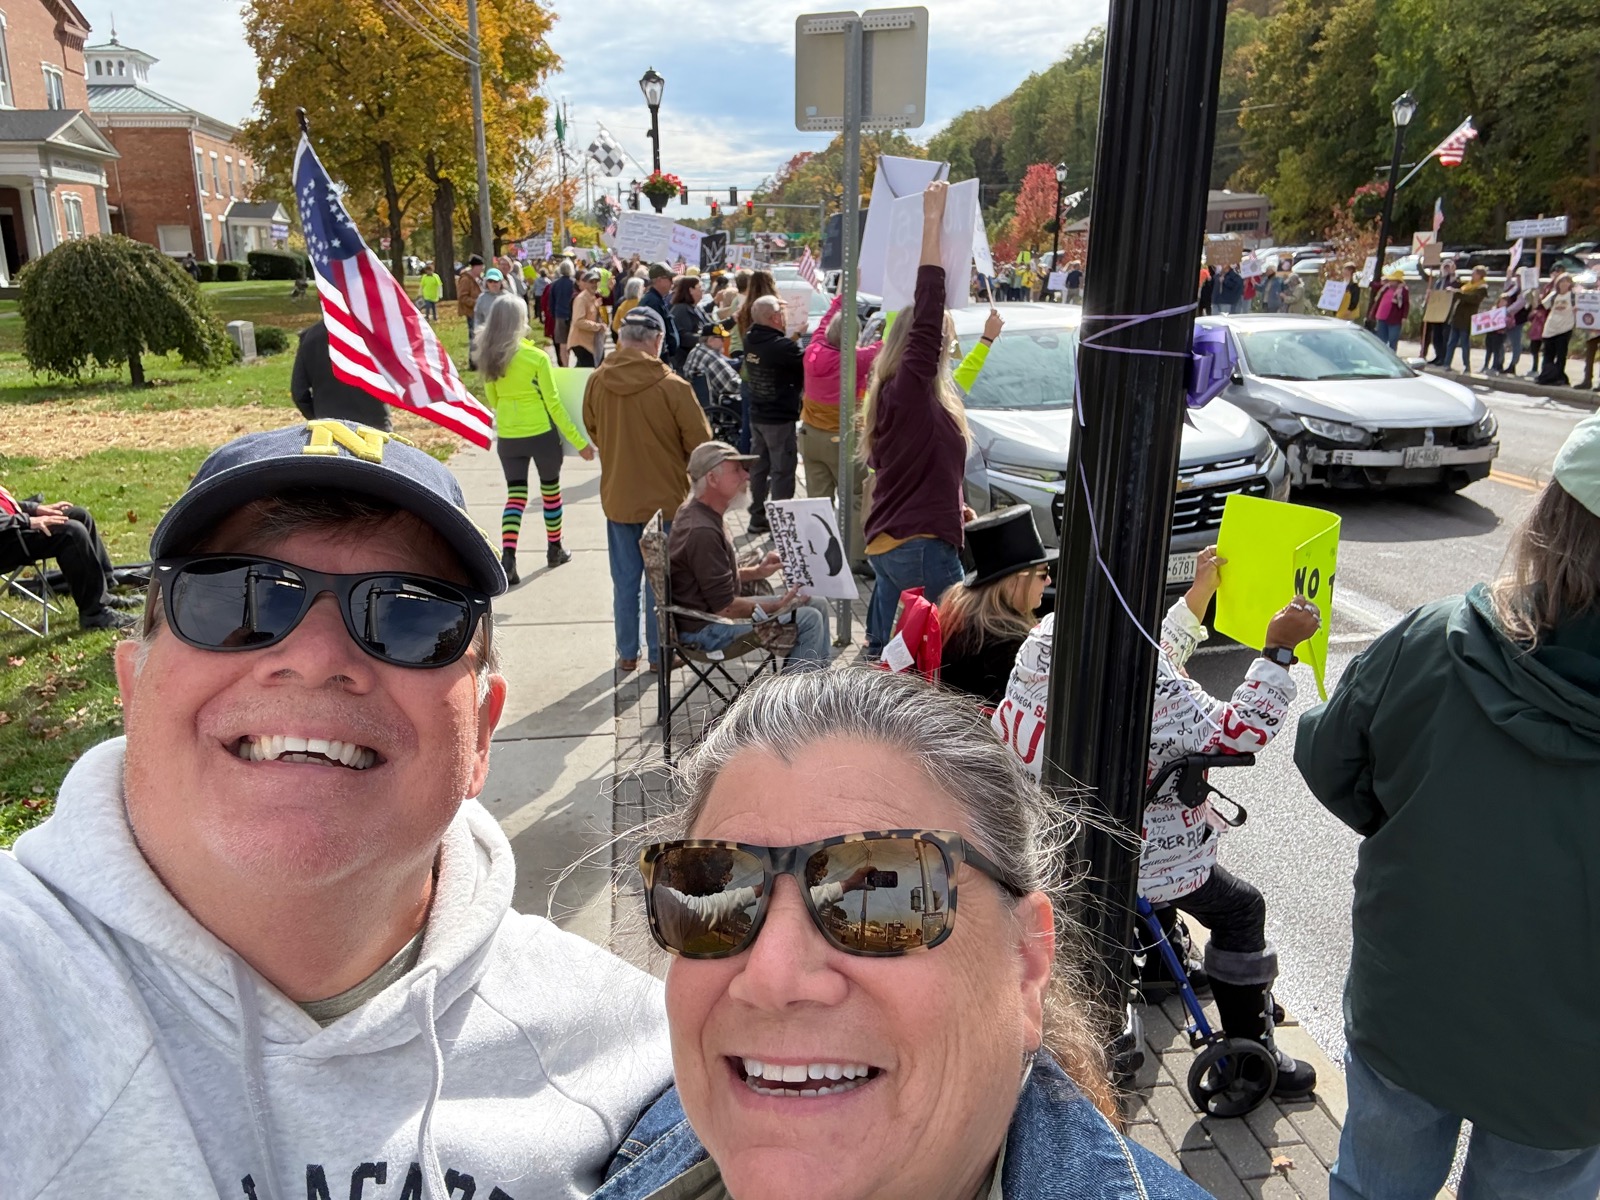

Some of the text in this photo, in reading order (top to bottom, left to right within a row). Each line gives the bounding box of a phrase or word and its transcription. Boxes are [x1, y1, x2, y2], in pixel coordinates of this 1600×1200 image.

[1172, 560, 1195, 576] 6781
[1294, 566, 1320, 599] NO
[1013, 690, 1032, 710] OMEGA
[1152, 719, 1175, 735] Good
[1177, 722, 1193, 736] of
[1150, 814, 1176, 824] World
